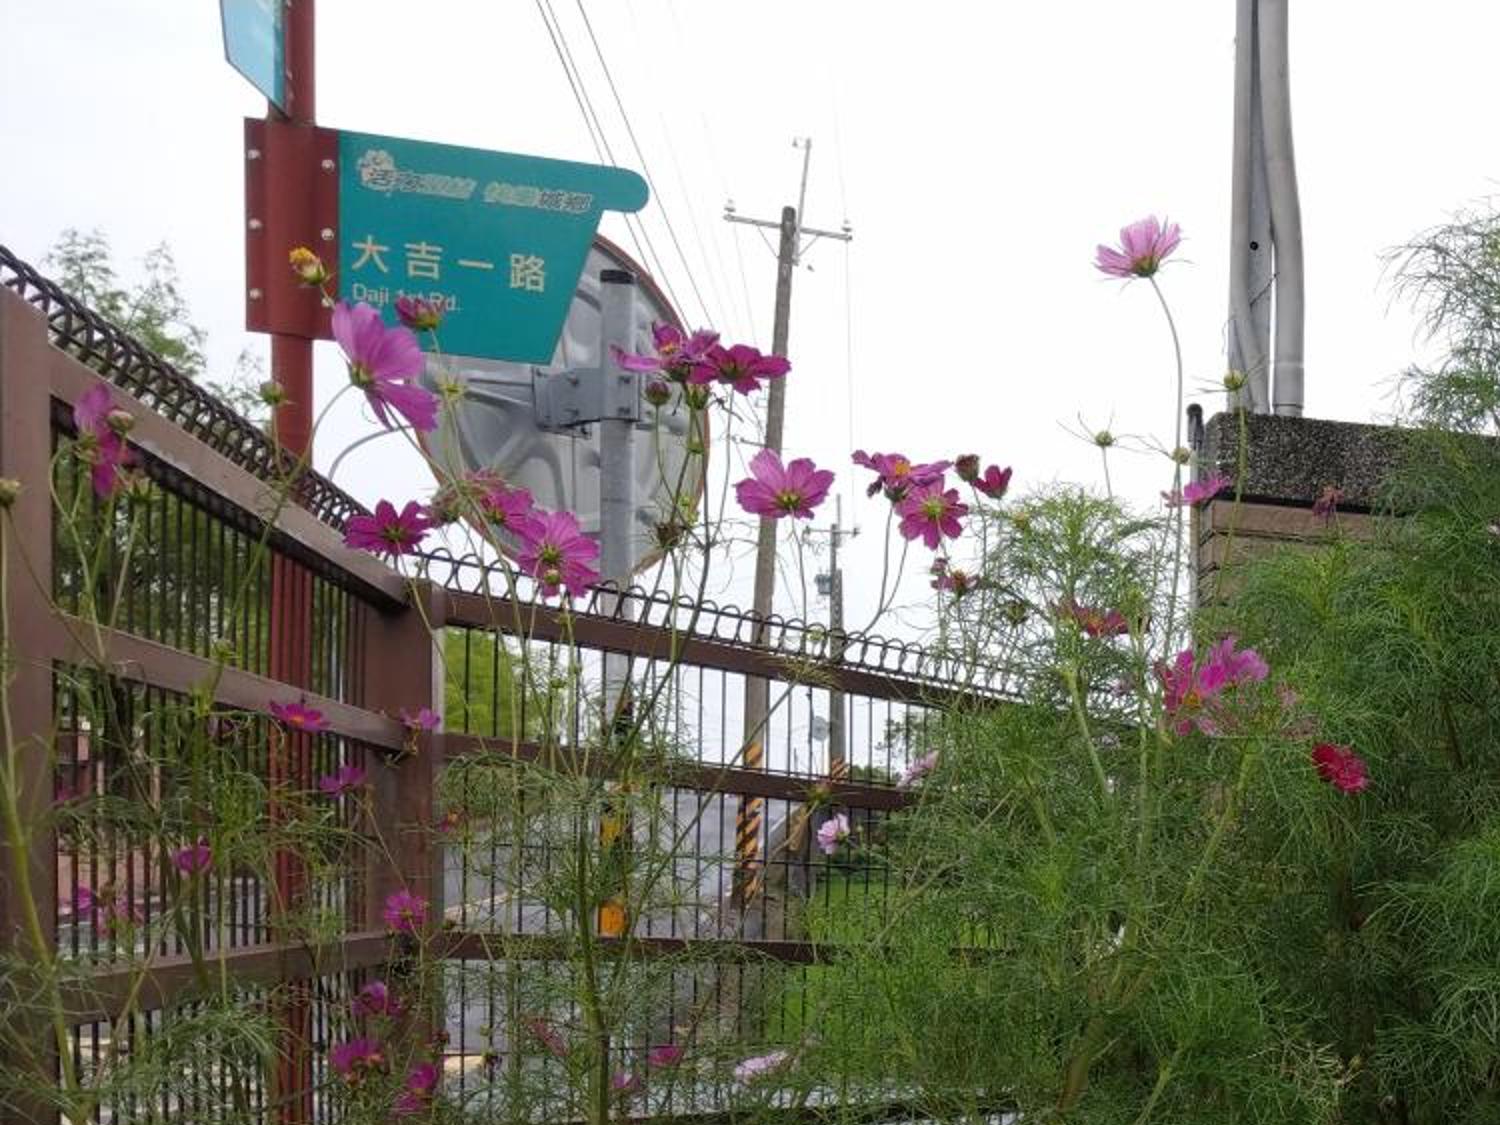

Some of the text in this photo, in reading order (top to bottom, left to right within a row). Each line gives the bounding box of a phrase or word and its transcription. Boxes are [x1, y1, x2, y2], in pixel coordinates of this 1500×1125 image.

[351, 234, 546, 293] 大吉一路
[352, 282, 389, 306] Daji
